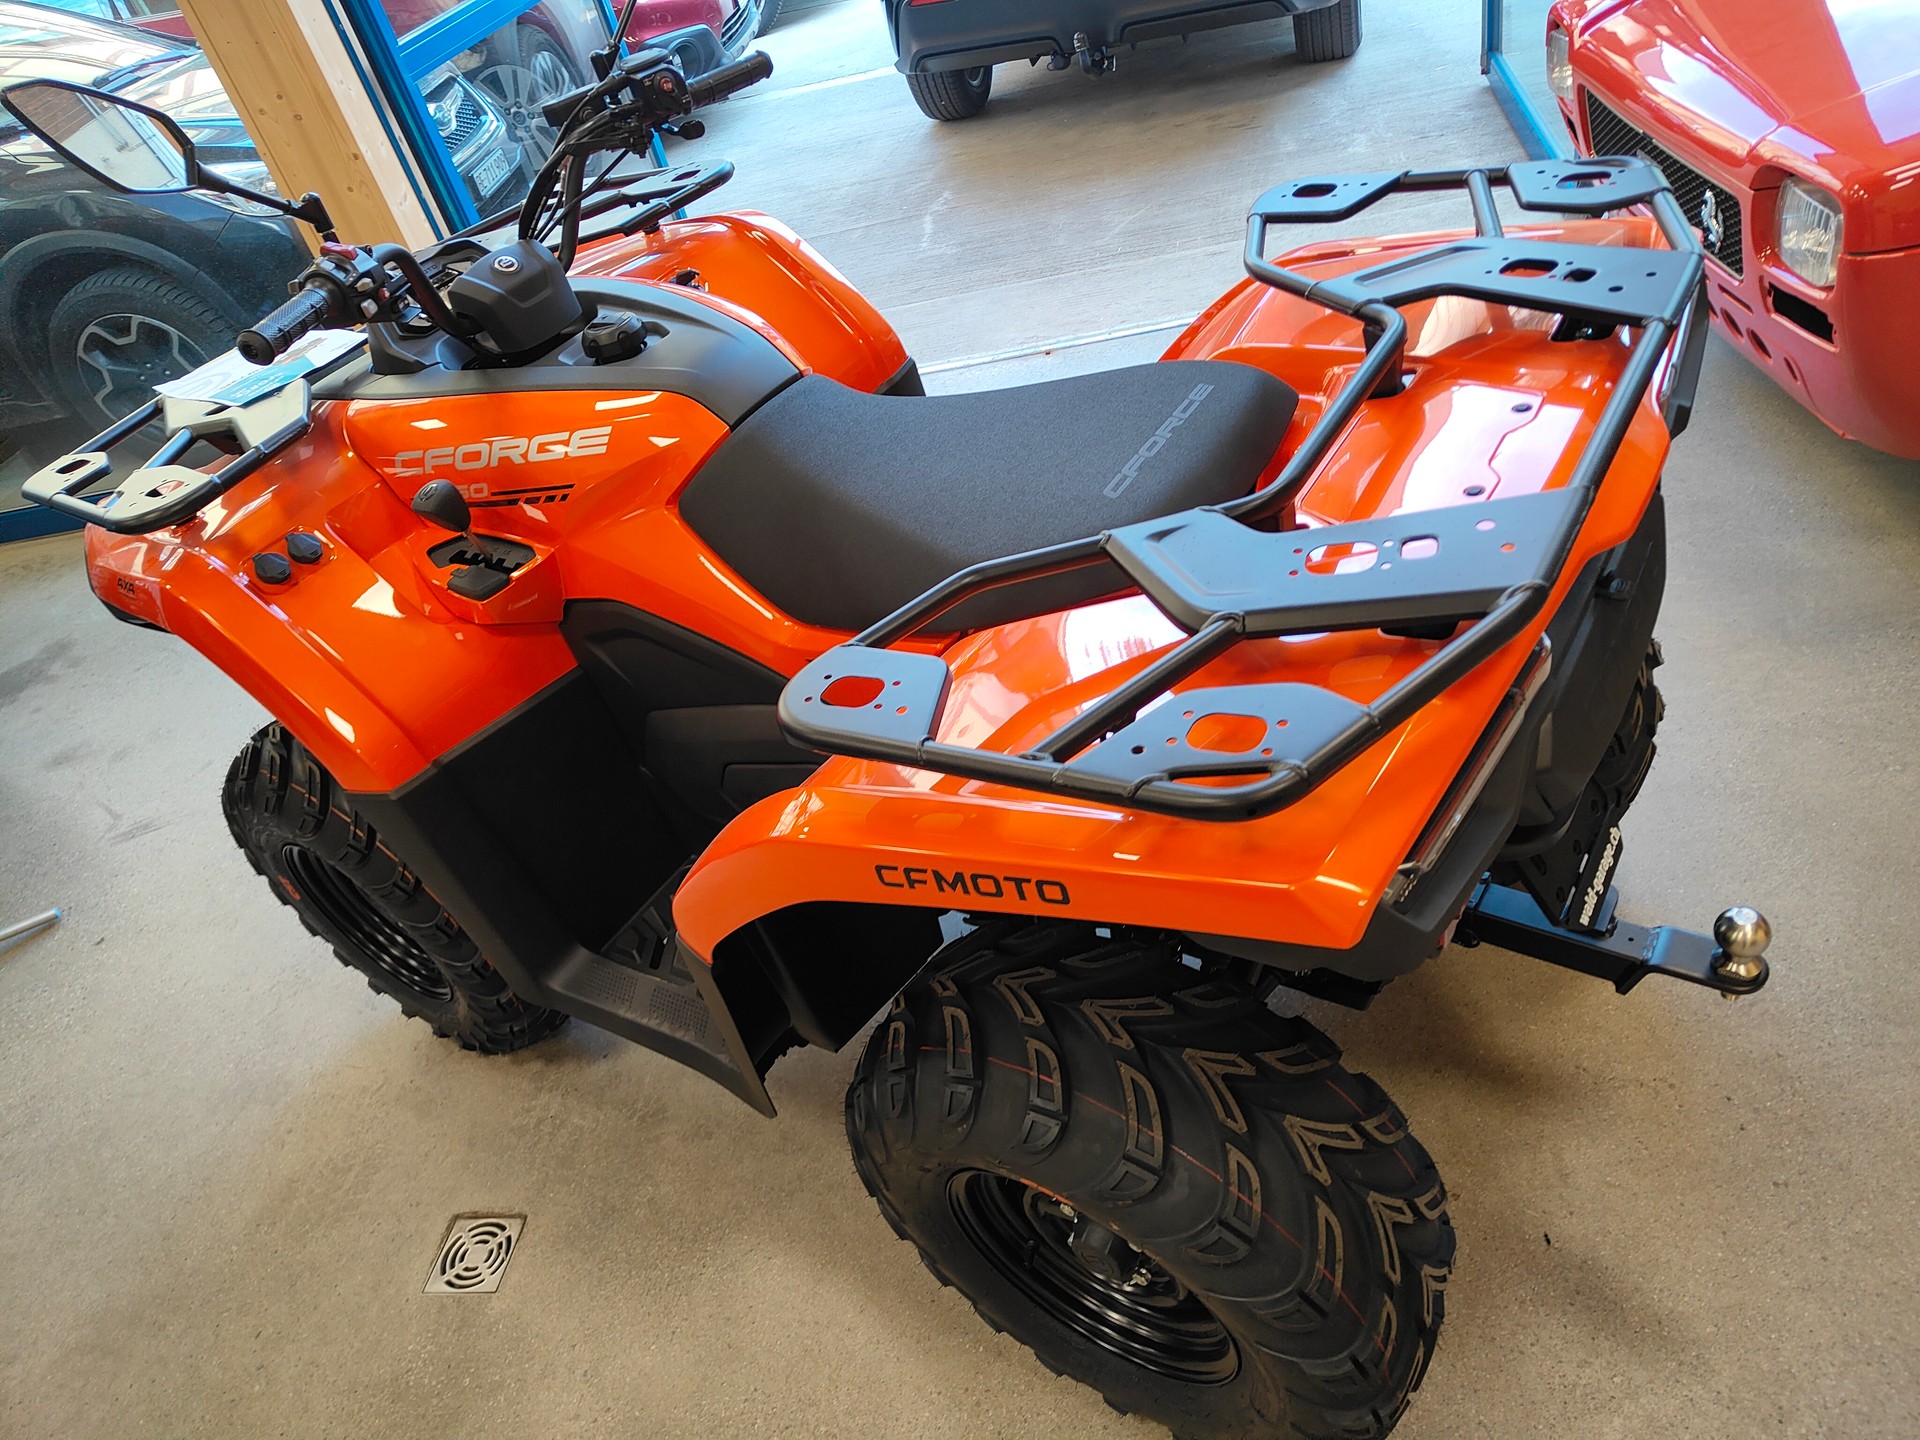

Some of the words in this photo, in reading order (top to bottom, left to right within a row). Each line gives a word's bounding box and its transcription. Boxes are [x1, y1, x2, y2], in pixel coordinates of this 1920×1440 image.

[394, 425, 613, 476] CFORCE
[1102, 383, 1215, 499] CFORCE
[874, 864, 1071, 906] CFMOTO
[1579, 826, 1621, 927] wald-garage.ch
